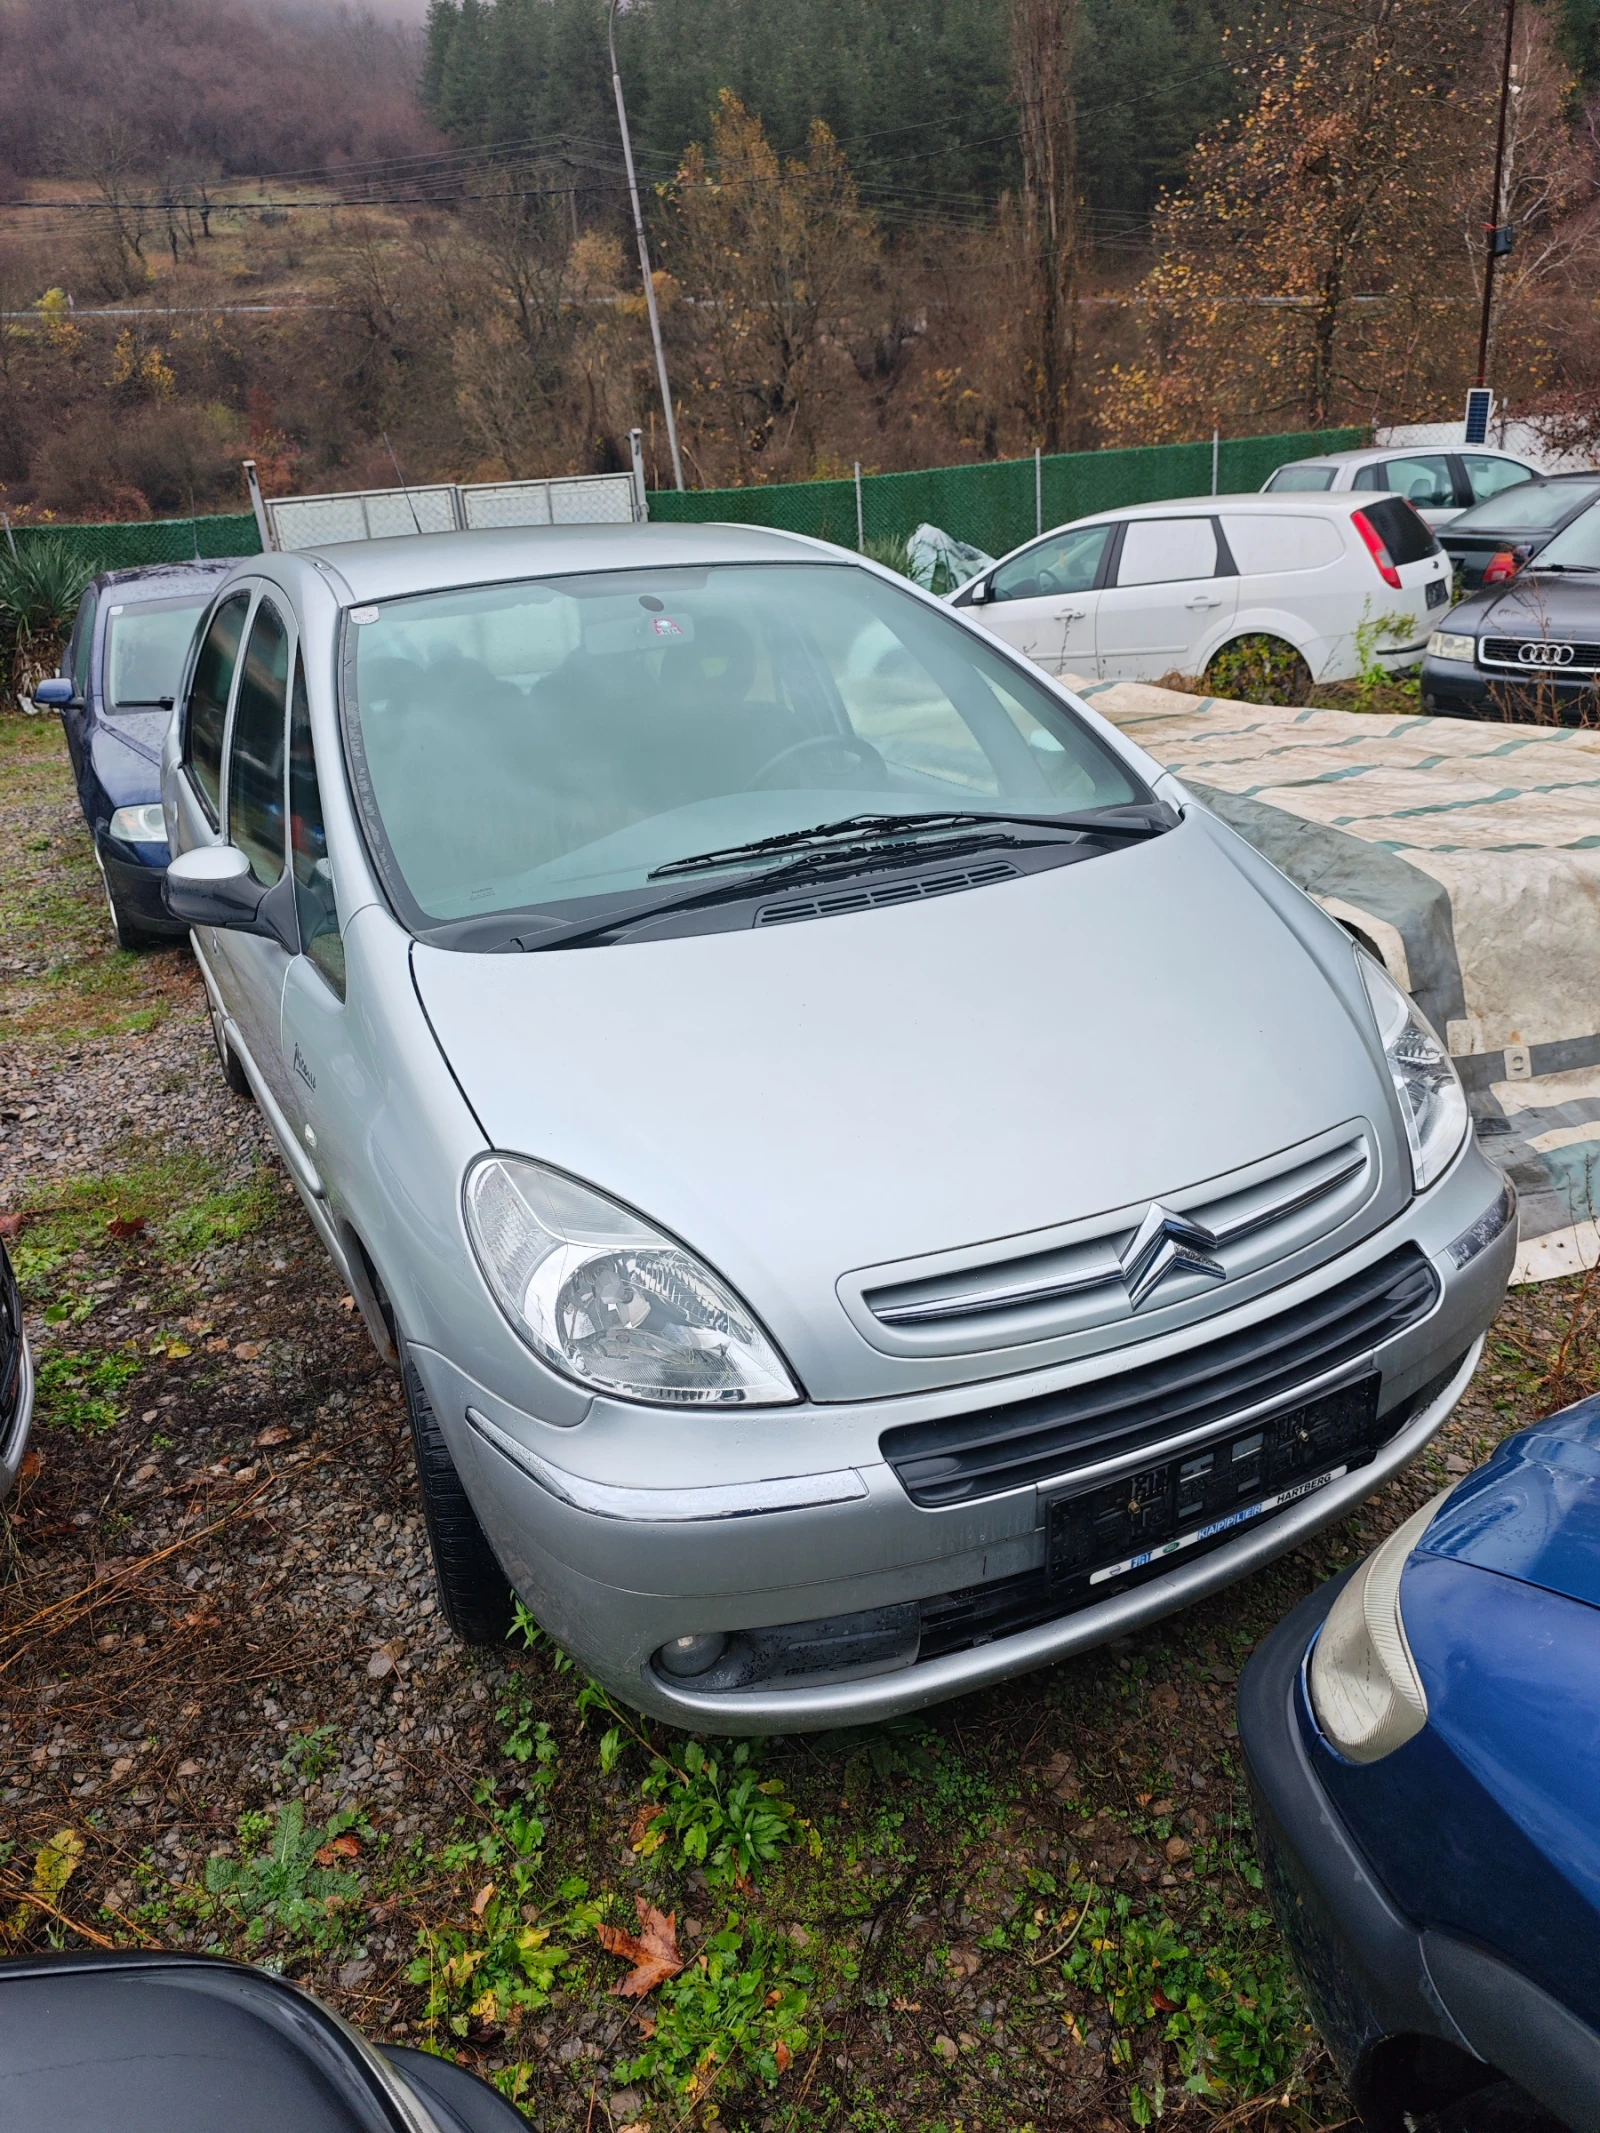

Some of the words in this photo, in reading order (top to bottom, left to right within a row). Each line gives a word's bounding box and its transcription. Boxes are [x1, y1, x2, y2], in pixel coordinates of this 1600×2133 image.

[1130, 1551, 1153, 1569] FIAT
[1197, 1503, 1262, 1541] KAPPLER
[1276, 1473, 1332, 1504] HARTBERG
